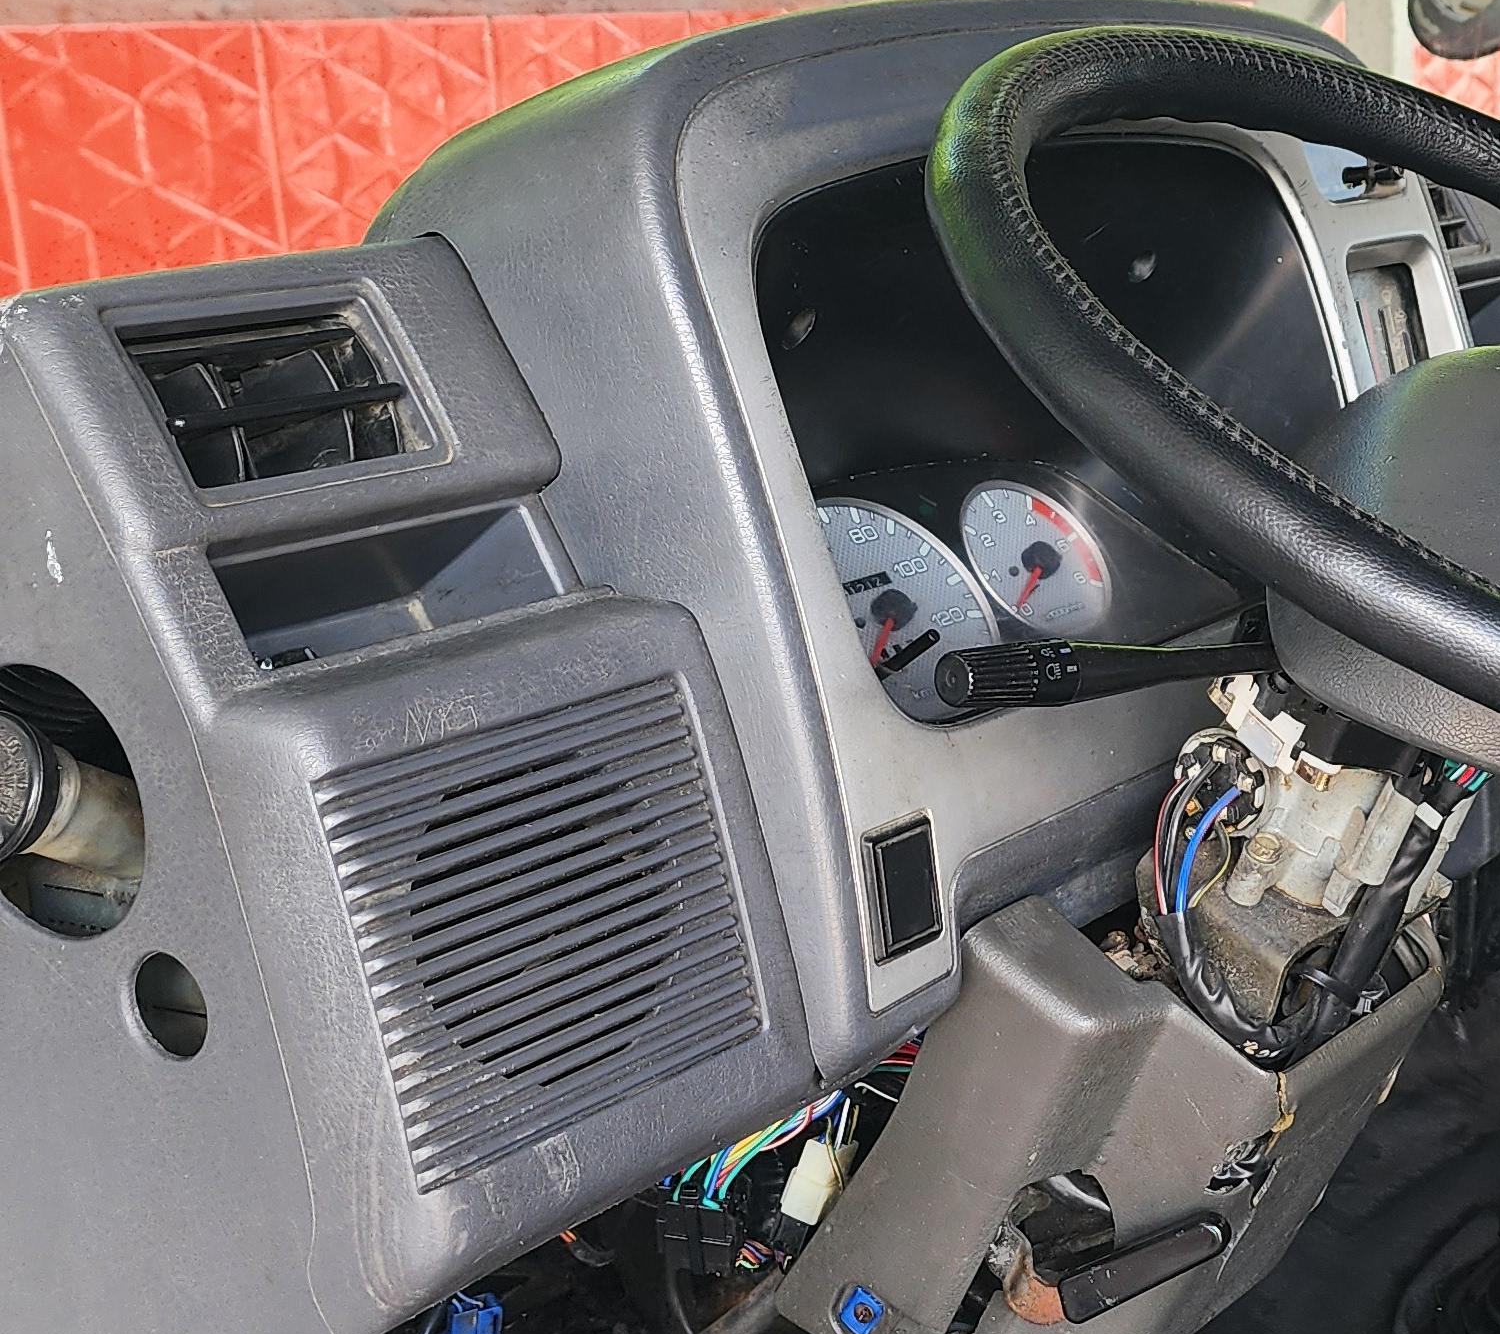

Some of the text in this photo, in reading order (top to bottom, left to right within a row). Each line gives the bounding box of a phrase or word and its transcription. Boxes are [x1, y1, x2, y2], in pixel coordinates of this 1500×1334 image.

[992, 509, 1007, 524] 3
[1025, 514, 1037, 526] 4
[848, 525, 879, 544] 80
[980, 533, 996, 548] 2
[1055, 538, 1070, 553] 5
[893, 557, 929, 578] 100
[990, 568, 1003, 582] 1
[1073, 570, 1087, 585] 6
[1020, 602, 1034, 616] 0
[931, 606, 966, 628] 120
